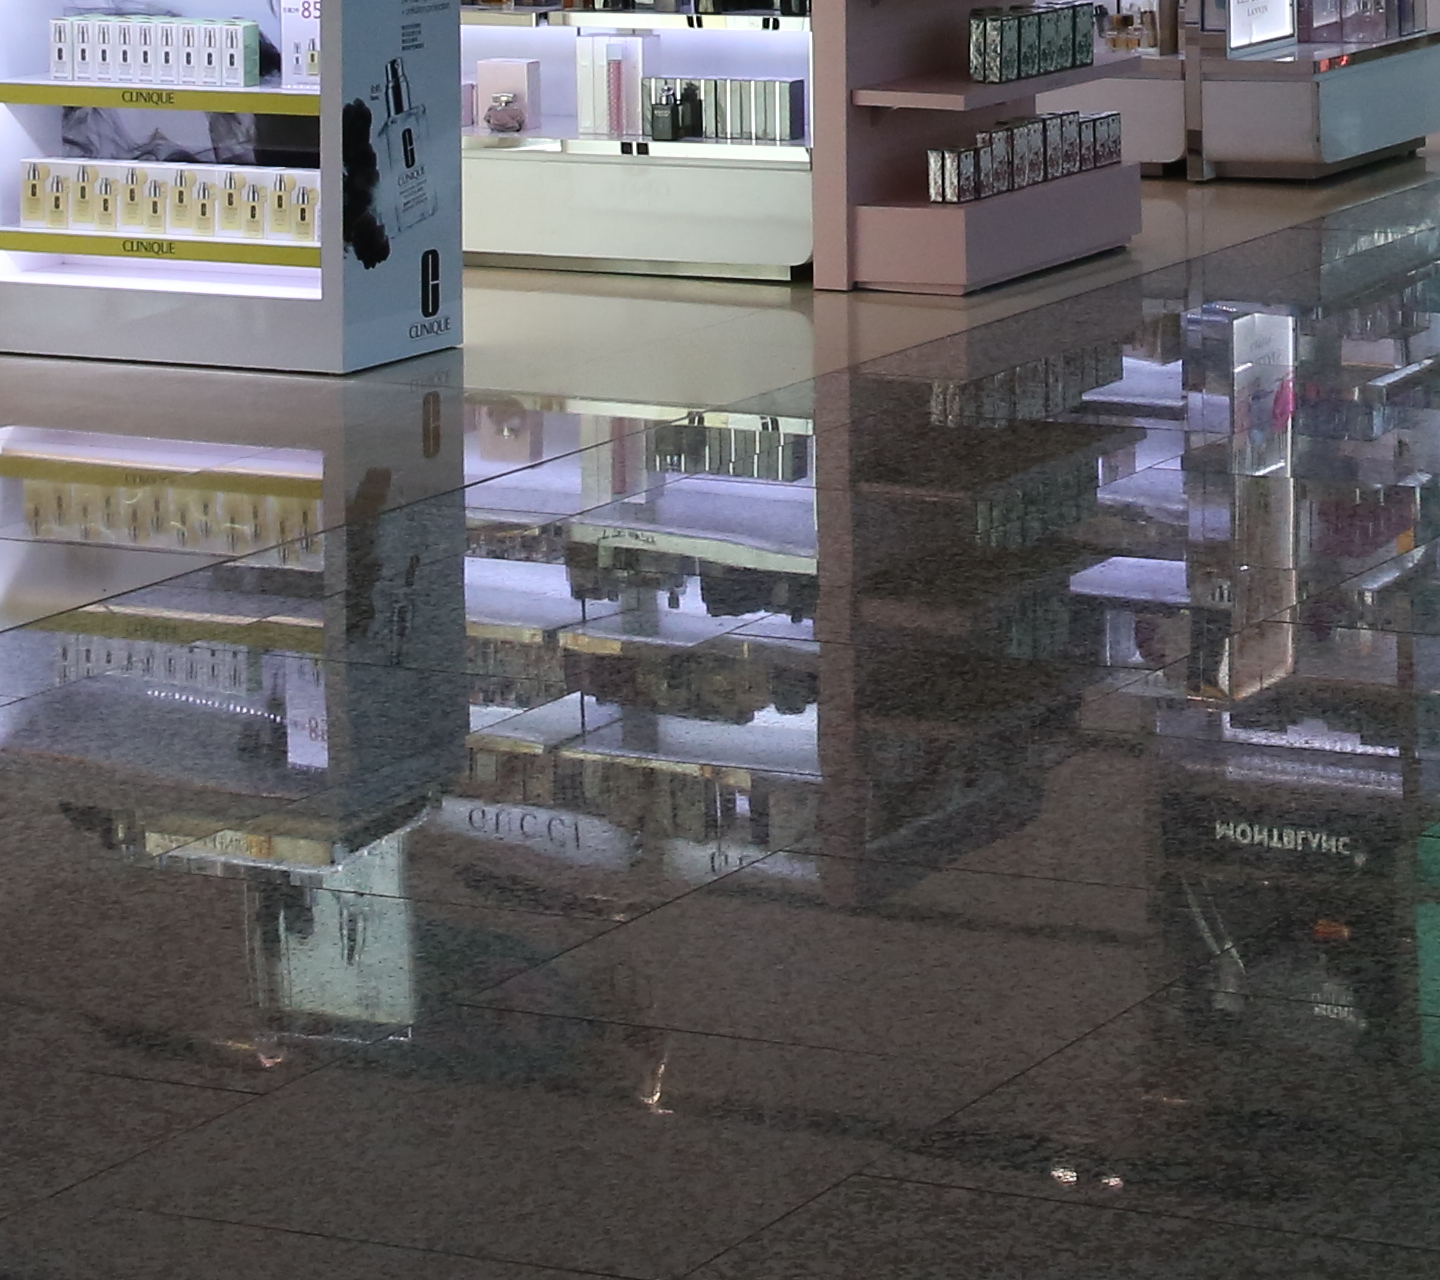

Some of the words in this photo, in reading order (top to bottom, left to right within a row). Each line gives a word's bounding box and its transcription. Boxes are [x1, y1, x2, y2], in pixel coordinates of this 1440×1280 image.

[121, 89, 175, 106] CLINIQUE
[397, 165, 427, 187] CLINIQUE
[122, 239, 176, 256] CLINIQUE
[409, 317, 451, 339] CLINIQUE
